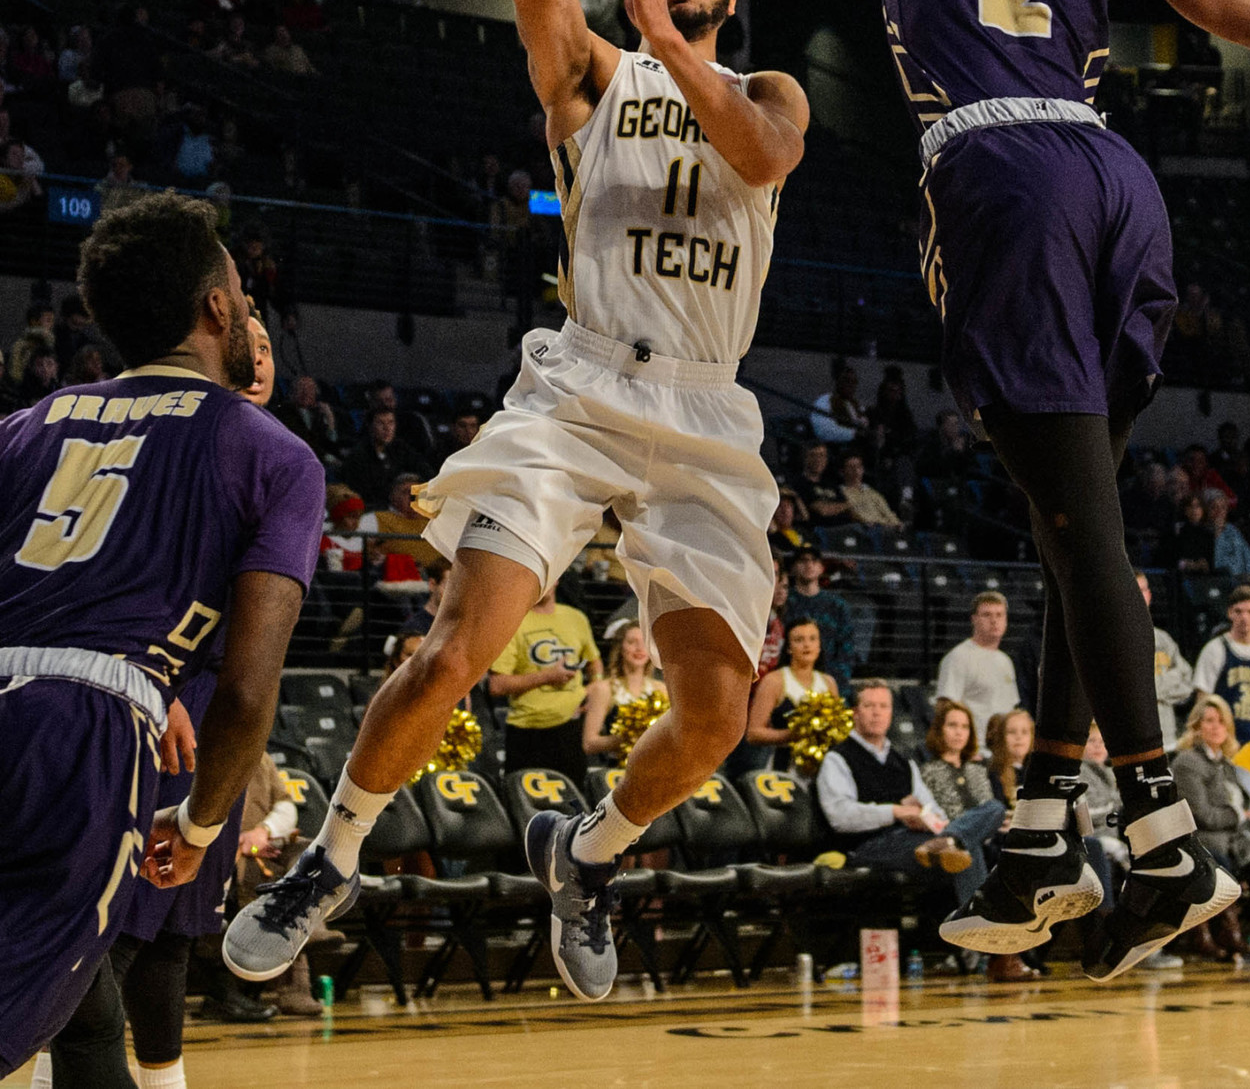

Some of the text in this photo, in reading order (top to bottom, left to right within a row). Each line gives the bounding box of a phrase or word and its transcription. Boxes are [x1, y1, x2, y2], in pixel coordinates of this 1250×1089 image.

[616, 97, 710, 144] GEOR
[664, 156, 702, 217] 11
[58, 197, 91, 218] 109
[627, 227, 741, 292] TECH
[45, 390, 208, 425] BRAVES
[14, 435, 146, 572] 5
[436, 772, 481, 805] GT
[521, 771, 567, 803] GT
[755, 772, 797, 803] GT
